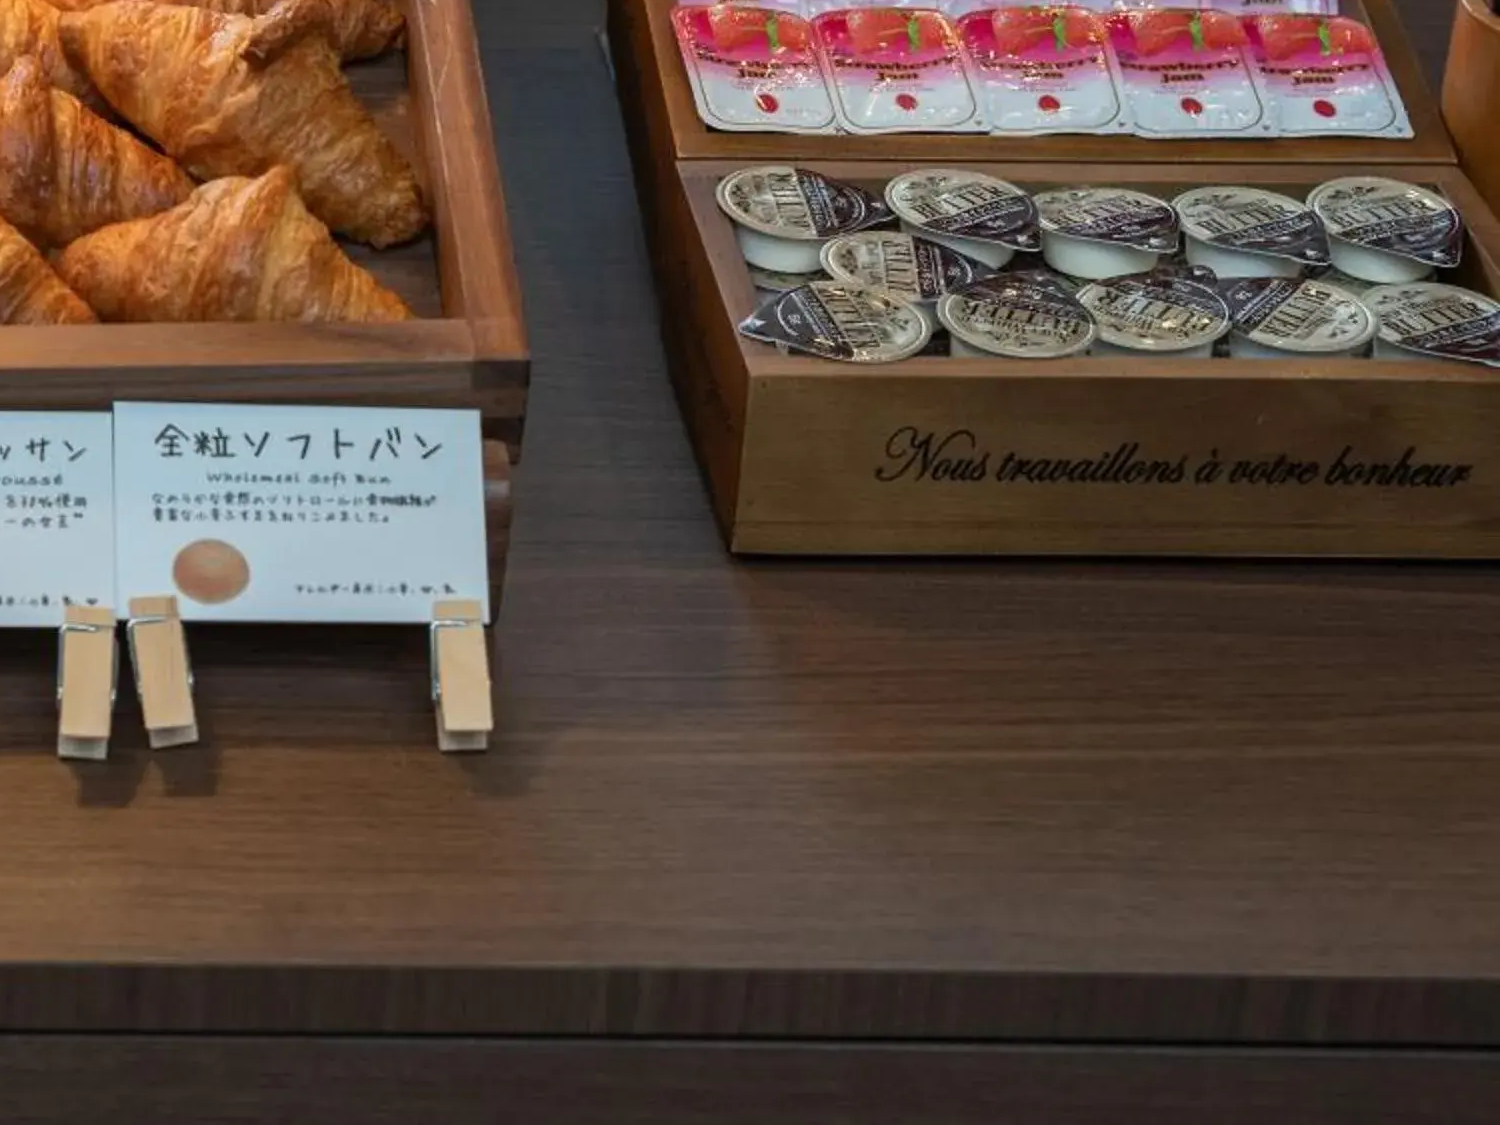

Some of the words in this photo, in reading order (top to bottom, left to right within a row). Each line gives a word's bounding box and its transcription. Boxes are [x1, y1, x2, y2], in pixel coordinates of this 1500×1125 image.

[908, 183, 1016, 221] BUTTER
[155, 423, 443, 461] 全粒ソフトバン
[875, 426, 990, 483] Nous
[996, 442, 1187, 484] travaillons
[1194, 447, 1222, 485] à
[1228, 454, 1312, 486] votre
[1325, 445, 1473, 488] bonheur
